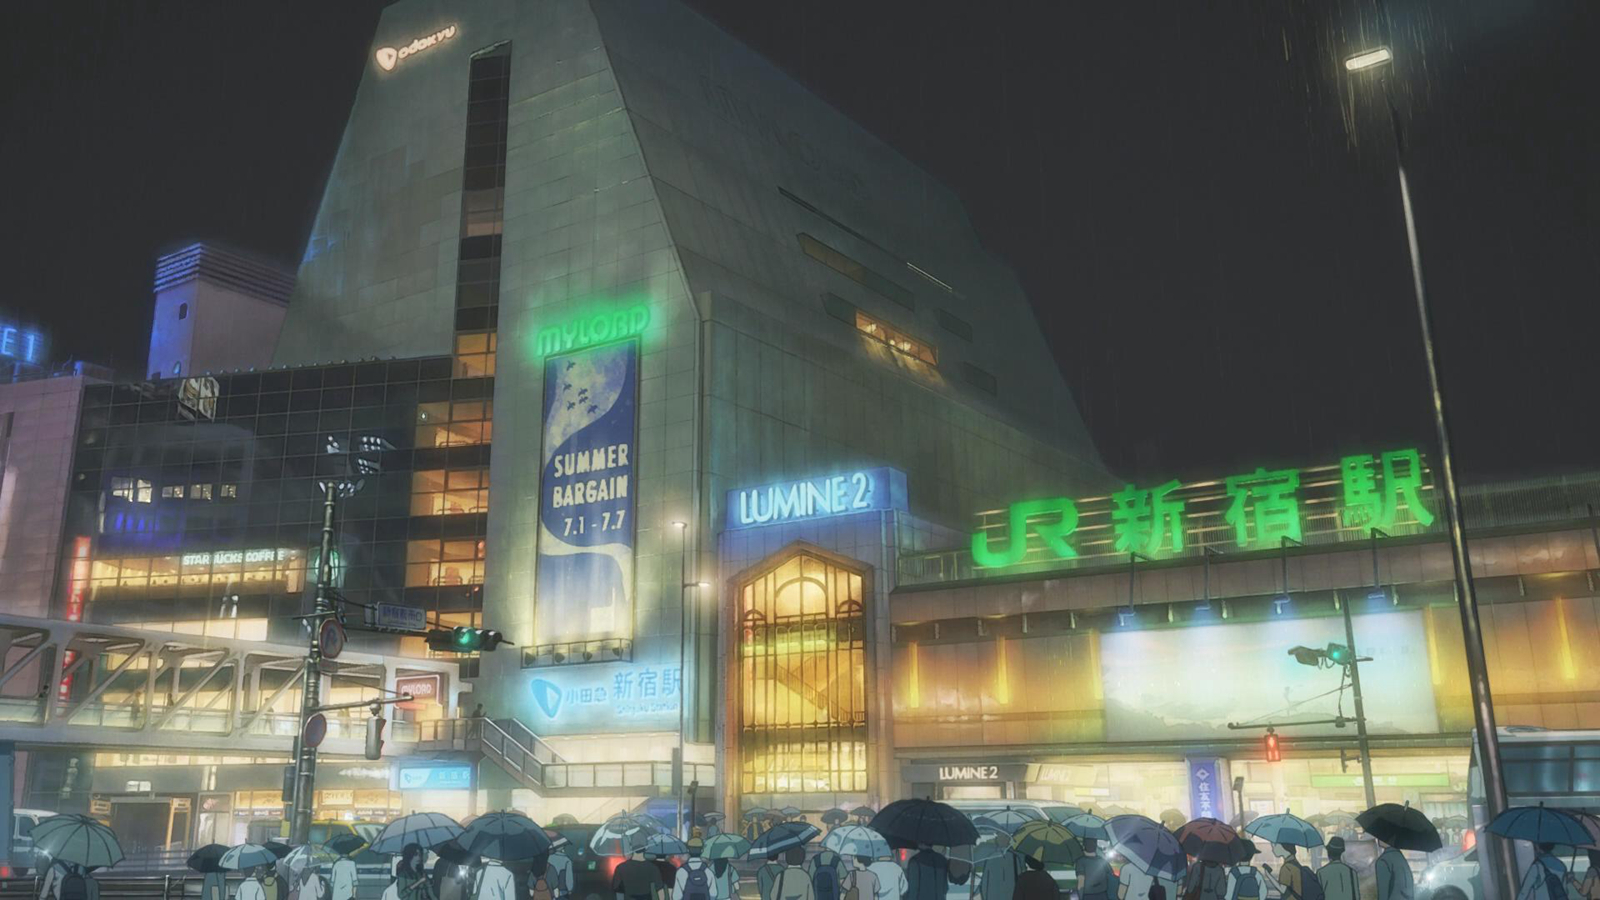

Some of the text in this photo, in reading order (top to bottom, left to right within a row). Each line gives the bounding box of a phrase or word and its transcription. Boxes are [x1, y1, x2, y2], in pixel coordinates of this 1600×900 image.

[536, 304, 651, 356] MYLORD
[554, 444, 629, 478] SUMMER
[552, 474, 629, 508] BARGAIN
[740, 471, 869, 524] LUMINE 2
[613, 667, 681, 701] 新宿駅
[939, 765, 999, 781] LUMINE 2
